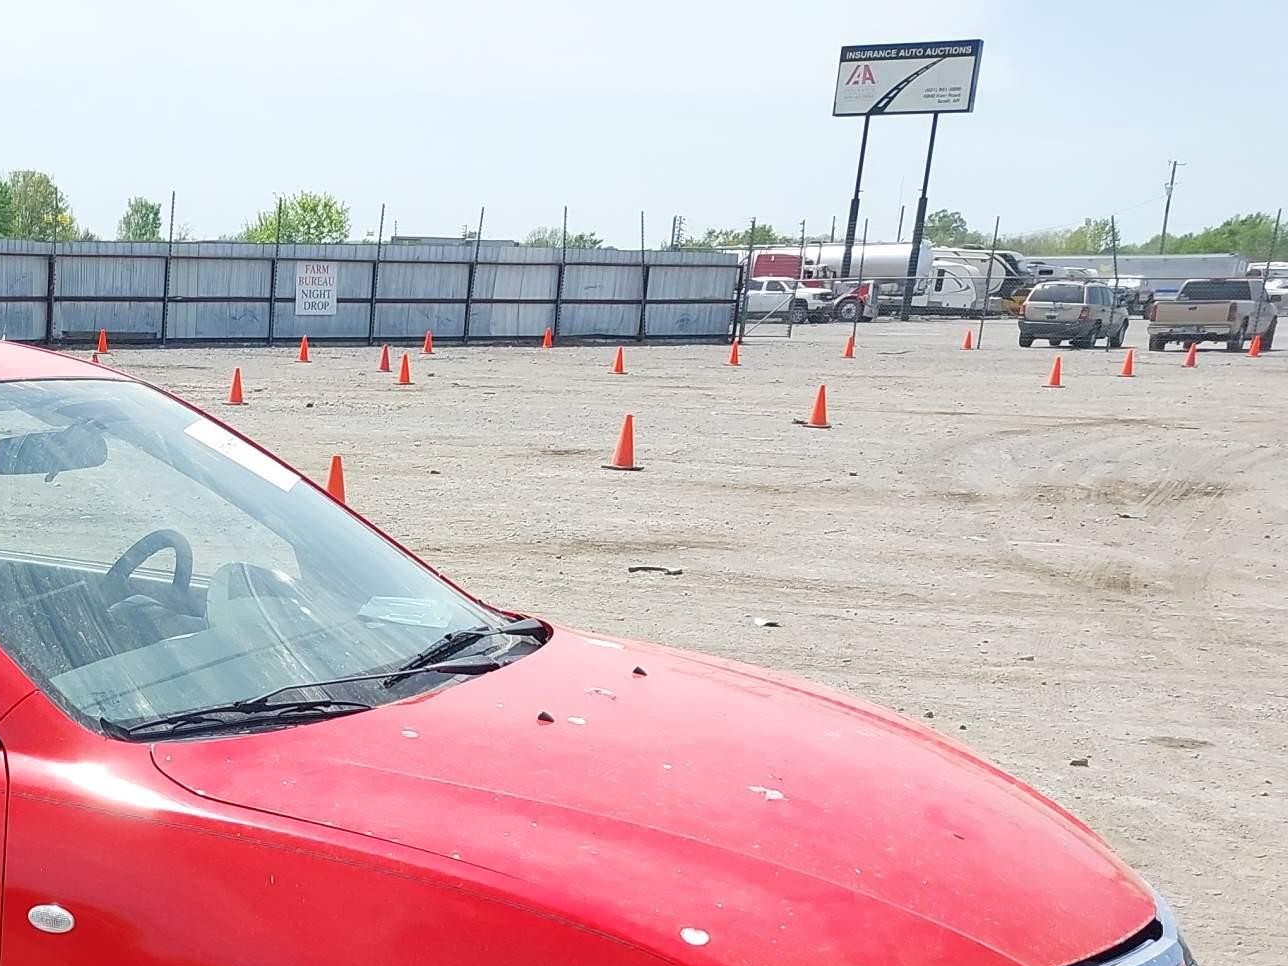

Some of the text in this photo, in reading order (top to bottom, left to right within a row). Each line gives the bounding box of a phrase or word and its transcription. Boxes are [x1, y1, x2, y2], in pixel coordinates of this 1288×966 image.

[846, 45, 972, 59] INSURANCE AUTO AUCTIONS
[305, 264, 329, 274] FARM
[298, 276, 335, 286] BUREAU
[301, 289, 332, 299] NIGHT
[303, 301, 330, 311] DROP
